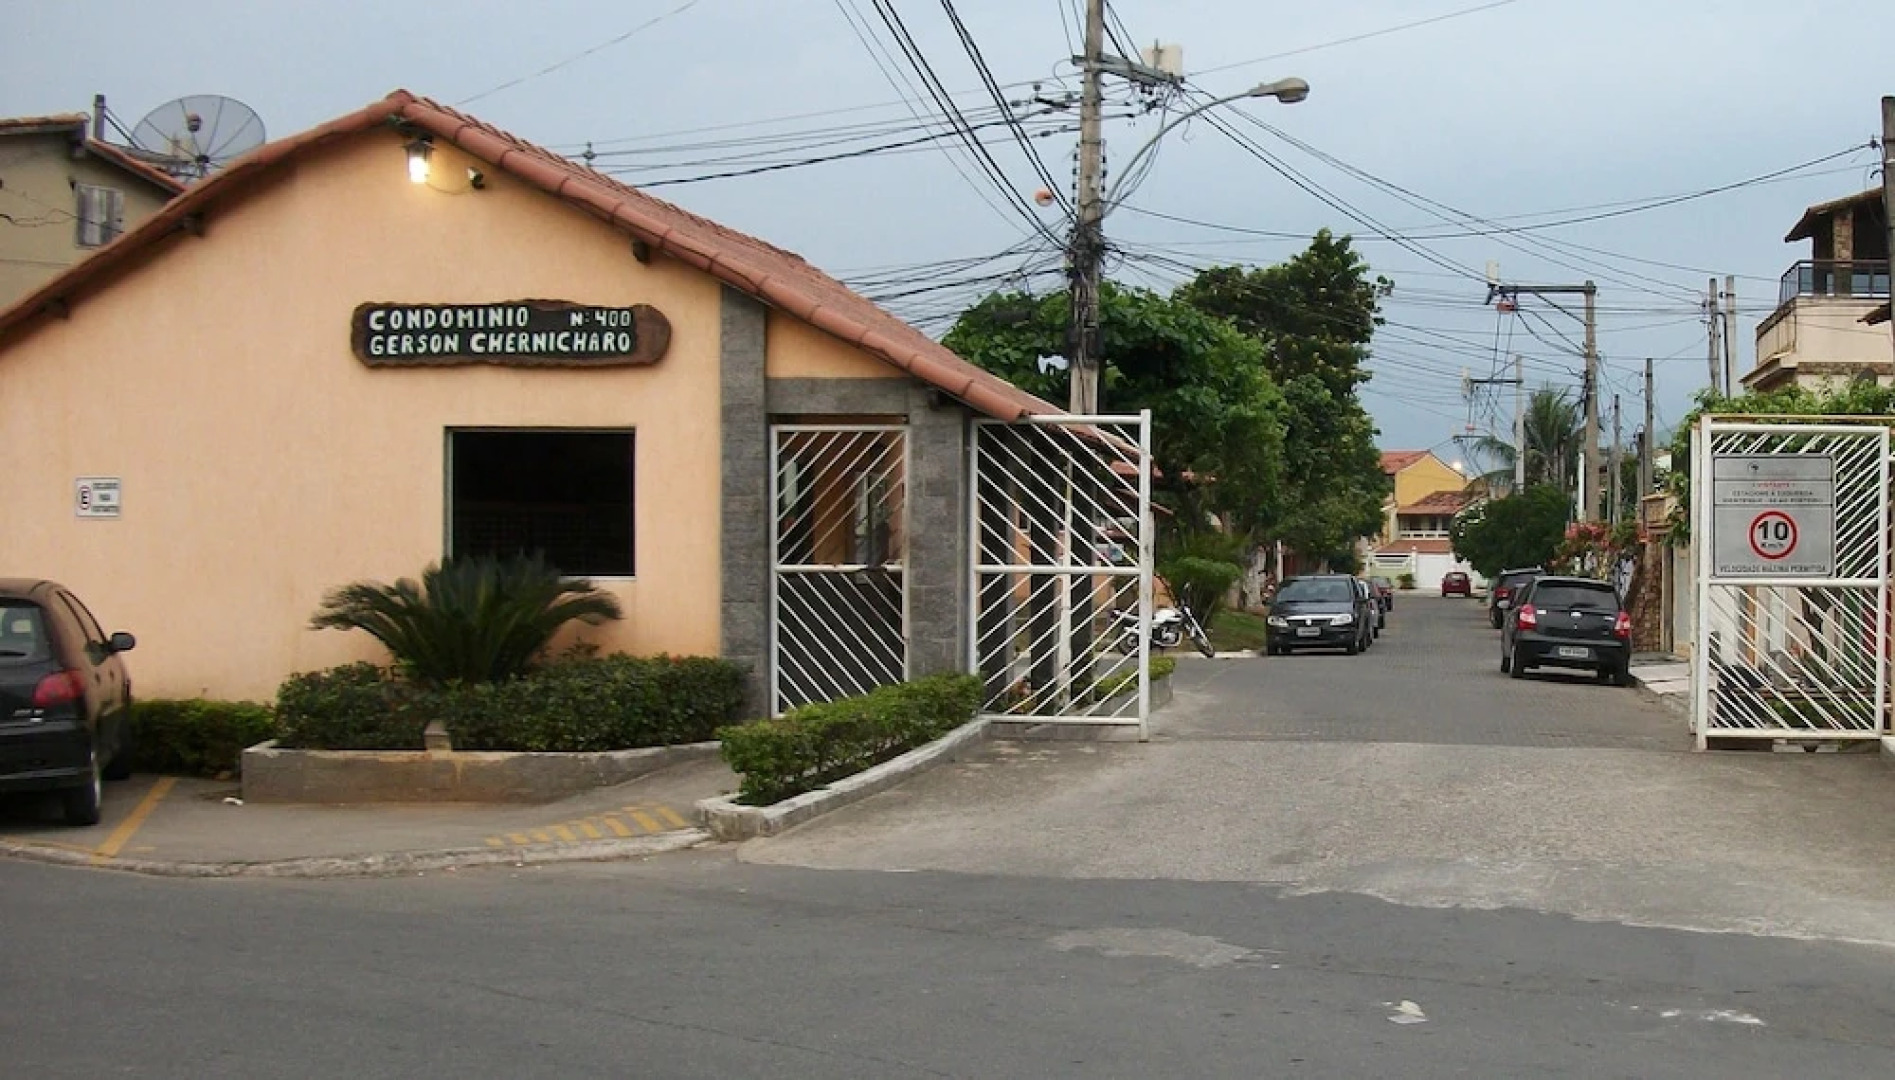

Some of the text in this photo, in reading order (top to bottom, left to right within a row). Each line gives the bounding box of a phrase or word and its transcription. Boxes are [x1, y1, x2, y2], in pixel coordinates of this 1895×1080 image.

[368, 307, 530, 330] CONDOMINIO
[594, 310, 631, 327] 400
[369, 332, 631, 355] GERSON CHERNICHARO
[1758, 520, 1789, 541] 10
